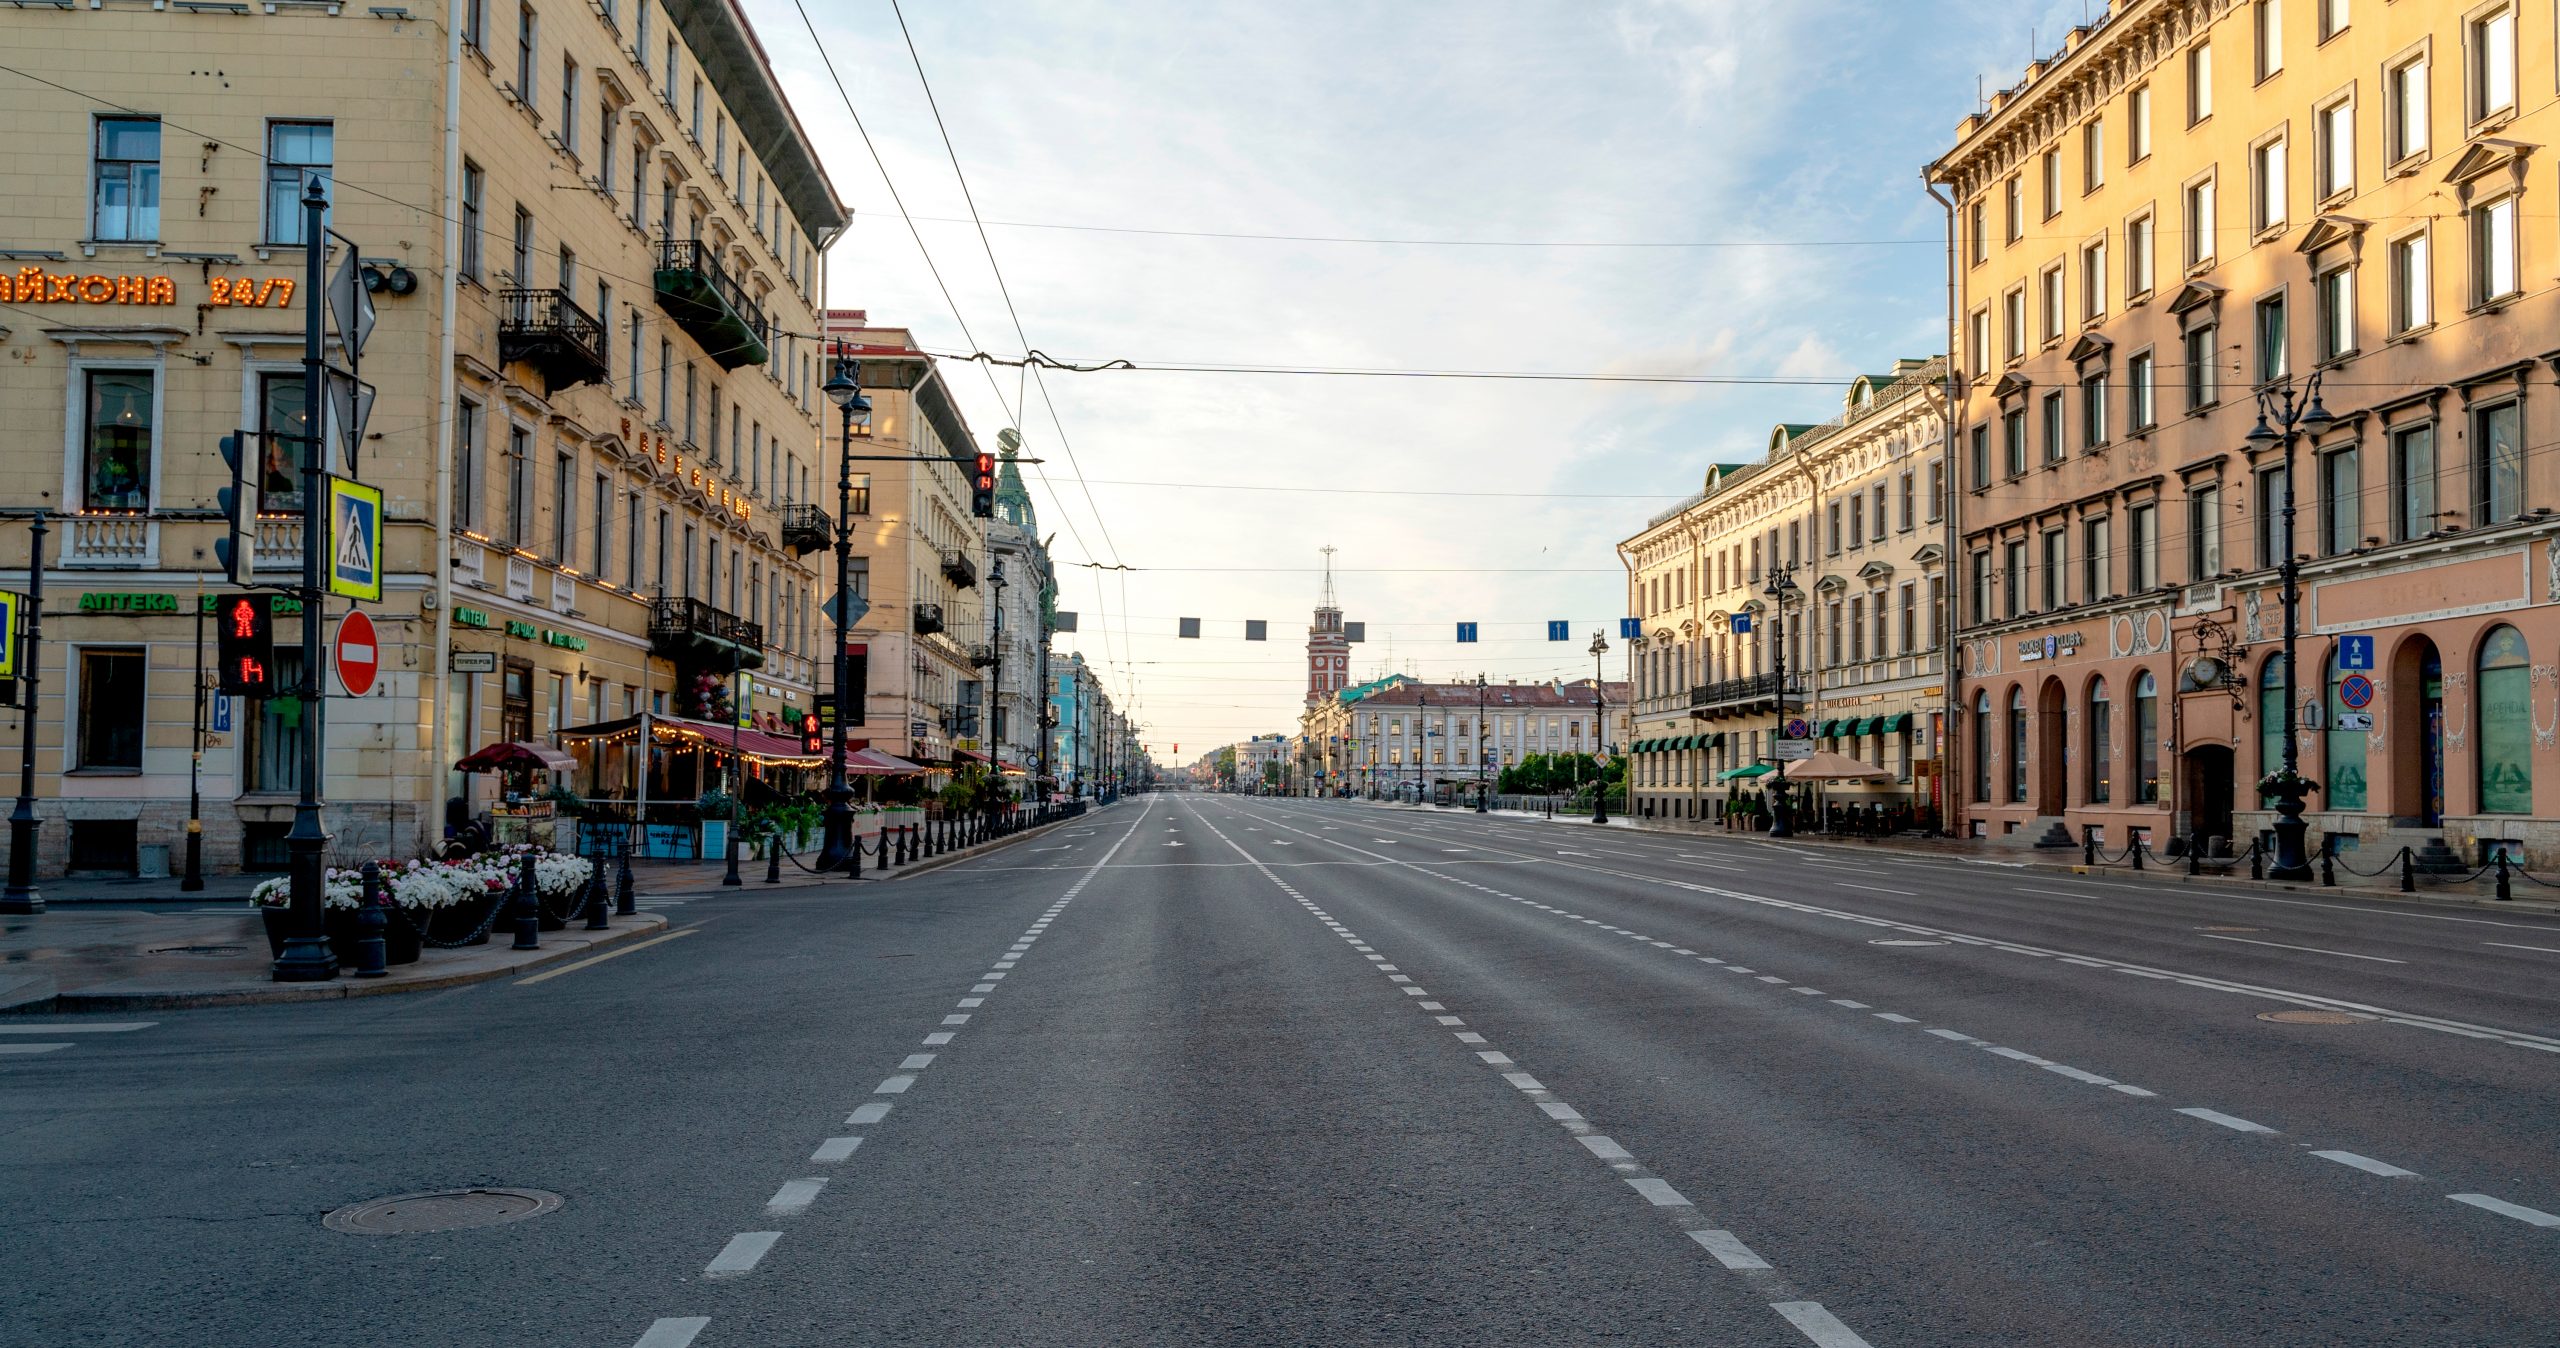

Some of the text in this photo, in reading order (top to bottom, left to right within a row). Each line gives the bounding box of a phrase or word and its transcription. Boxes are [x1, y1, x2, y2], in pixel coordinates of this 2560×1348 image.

[210, 276, 296, 308] 24/7
[78, 592, 304, 613] АПТЕКА 2 СА
[459, 606, 489, 627] АПТЕКА
[521, 622, 537, 640] ЧАСА
[2018, 632, 2075, 654] HOCKEY CLUB
